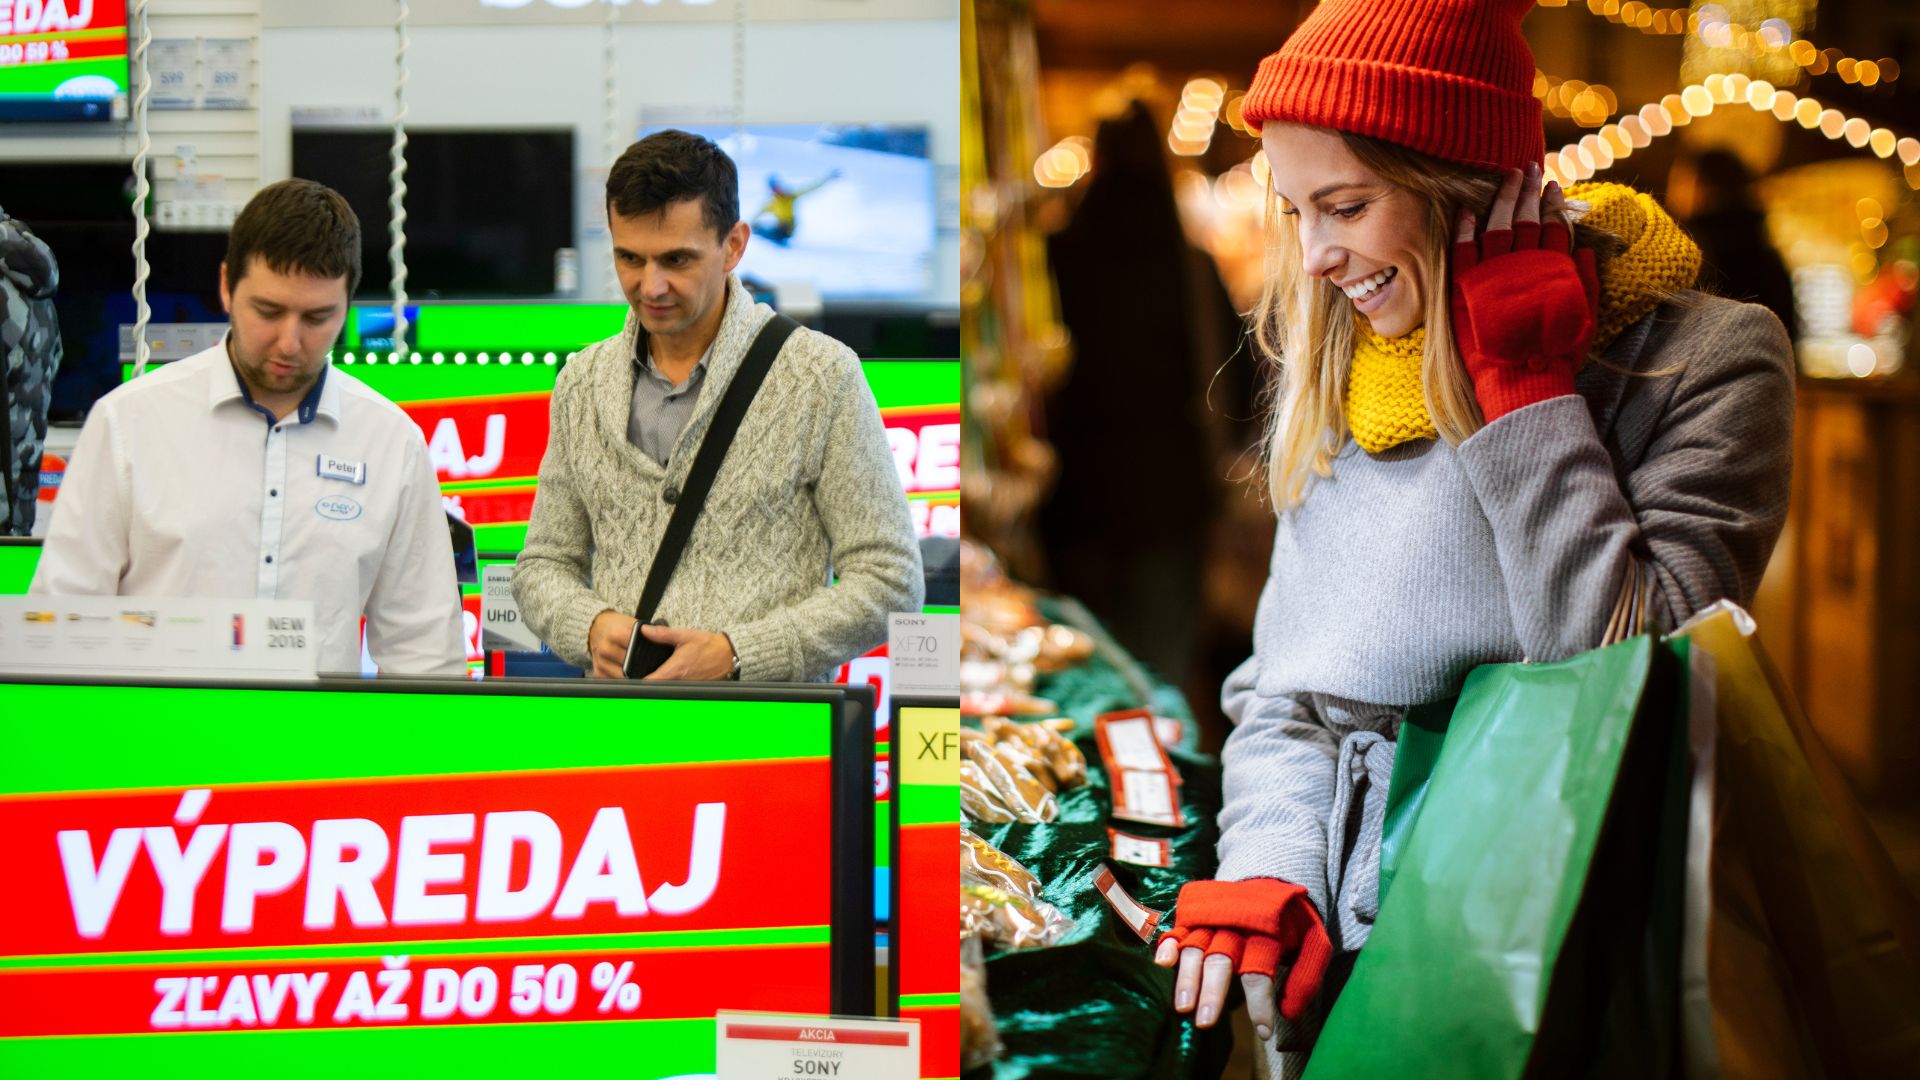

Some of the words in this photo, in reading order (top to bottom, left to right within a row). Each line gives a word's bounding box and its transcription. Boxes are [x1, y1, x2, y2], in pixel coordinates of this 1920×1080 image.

[328, 460, 357, 473] Peter
[487, 609, 517, 622] UHD
[267, 616, 305, 630] NEW
[267, 634, 306, 647] 2018
[895, 635, 937, 653] XF70
[57, 789, 726, 938] VÝPREDAJ
[150, 972, 329, 1027] ZĽAVY
[332, 955, 412, 1022] AŽ
[420, 967, 498, 1019] DO
[509, 963, 578, 1016] 50
[590, 960, 642, 1012] %
[799, 1028, 836, 1041] AKCIA
[793, 1059, 841, 1075] SONY
